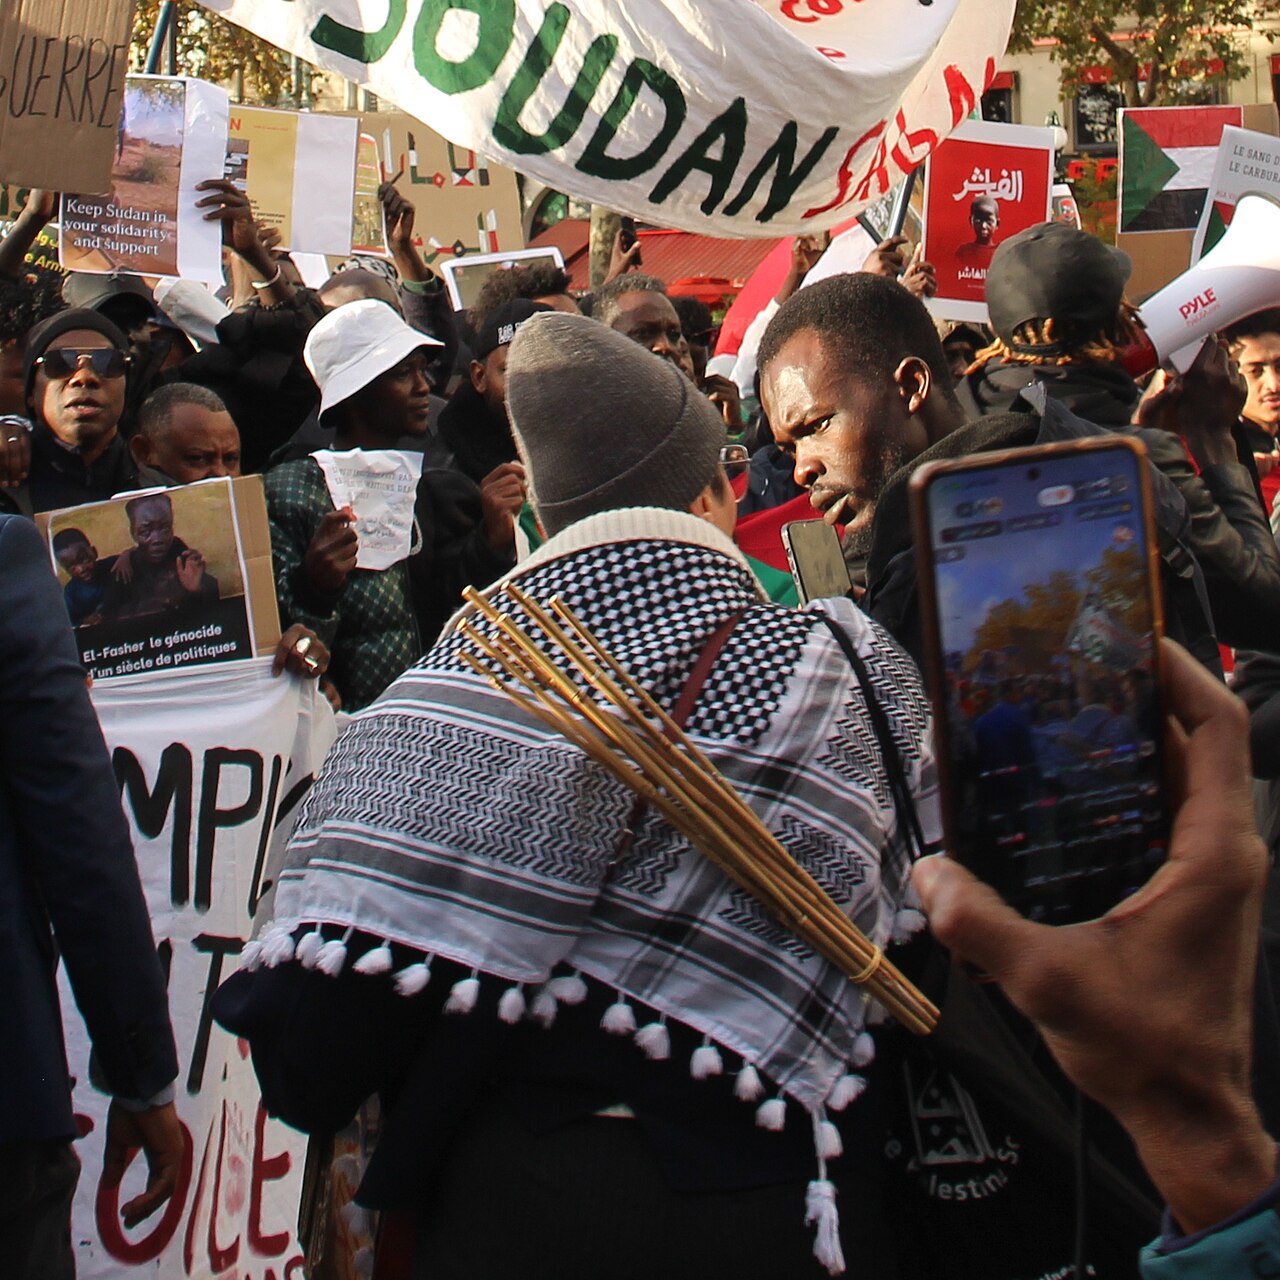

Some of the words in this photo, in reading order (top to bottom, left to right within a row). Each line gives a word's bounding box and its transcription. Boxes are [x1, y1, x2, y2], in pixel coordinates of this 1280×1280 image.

[1233, 144, 1245, 157] LE
[1246, 148, 1271, 164] SANG
[1228, 161, 1239, 173] LE
[66, 199, 103, 219] Keep
[106, 203, 150, 222] Sudan
[154, 210, 168, 224] in
[64, 219, 98, 233] your
[100, 223, 169, 242] solidarity
[73, 237, 101, 249] and
[104, 238, 160, 256] support
[1178, 287, 1218, 320] PYLE
[83, 640, 145, 663] El-Fasher
[150, 637, 162, 649] le
[164, 623, 223, 649] génocide
[116, 655, 153, 675] siècle
[155, 653, 171, 667] de
[174, 640, 237, 666] politiques
